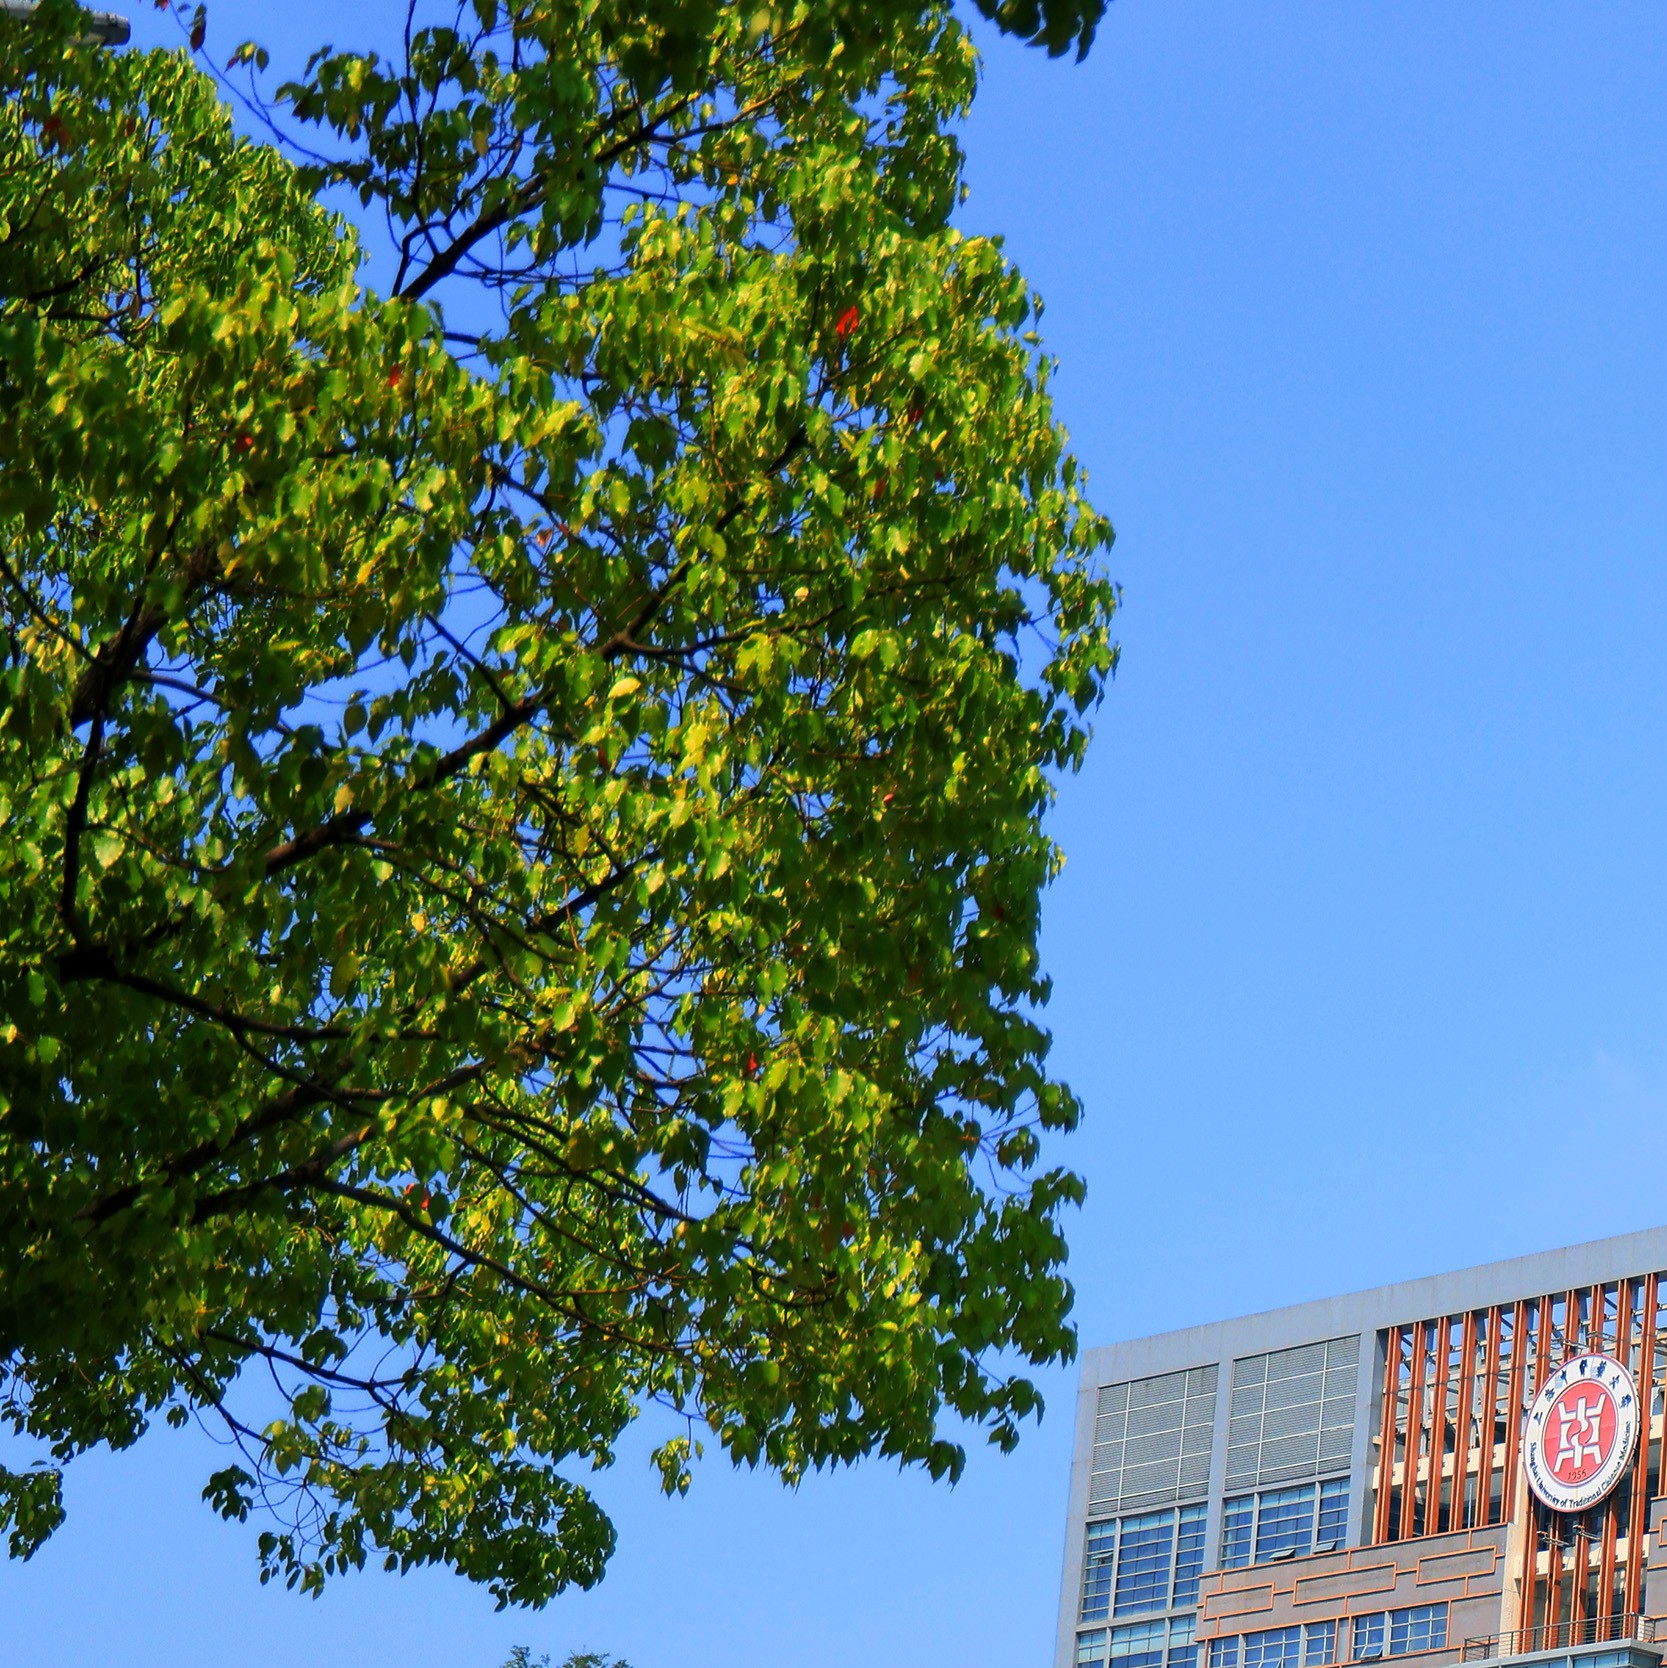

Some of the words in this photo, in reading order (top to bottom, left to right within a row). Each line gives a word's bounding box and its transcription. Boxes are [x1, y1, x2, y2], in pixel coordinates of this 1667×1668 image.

[1530, 1442, 1539, 1479] Shanghai
[1536, 1475, 1560, 1505] University
[1569, 1488, 1602, 1508] Traditional
[1601, 1461, 1622, 1490] Chinese
[1619, 1421, 1631, 1461] Medicine
[1567, 1469, 1587, 1481] 1956
